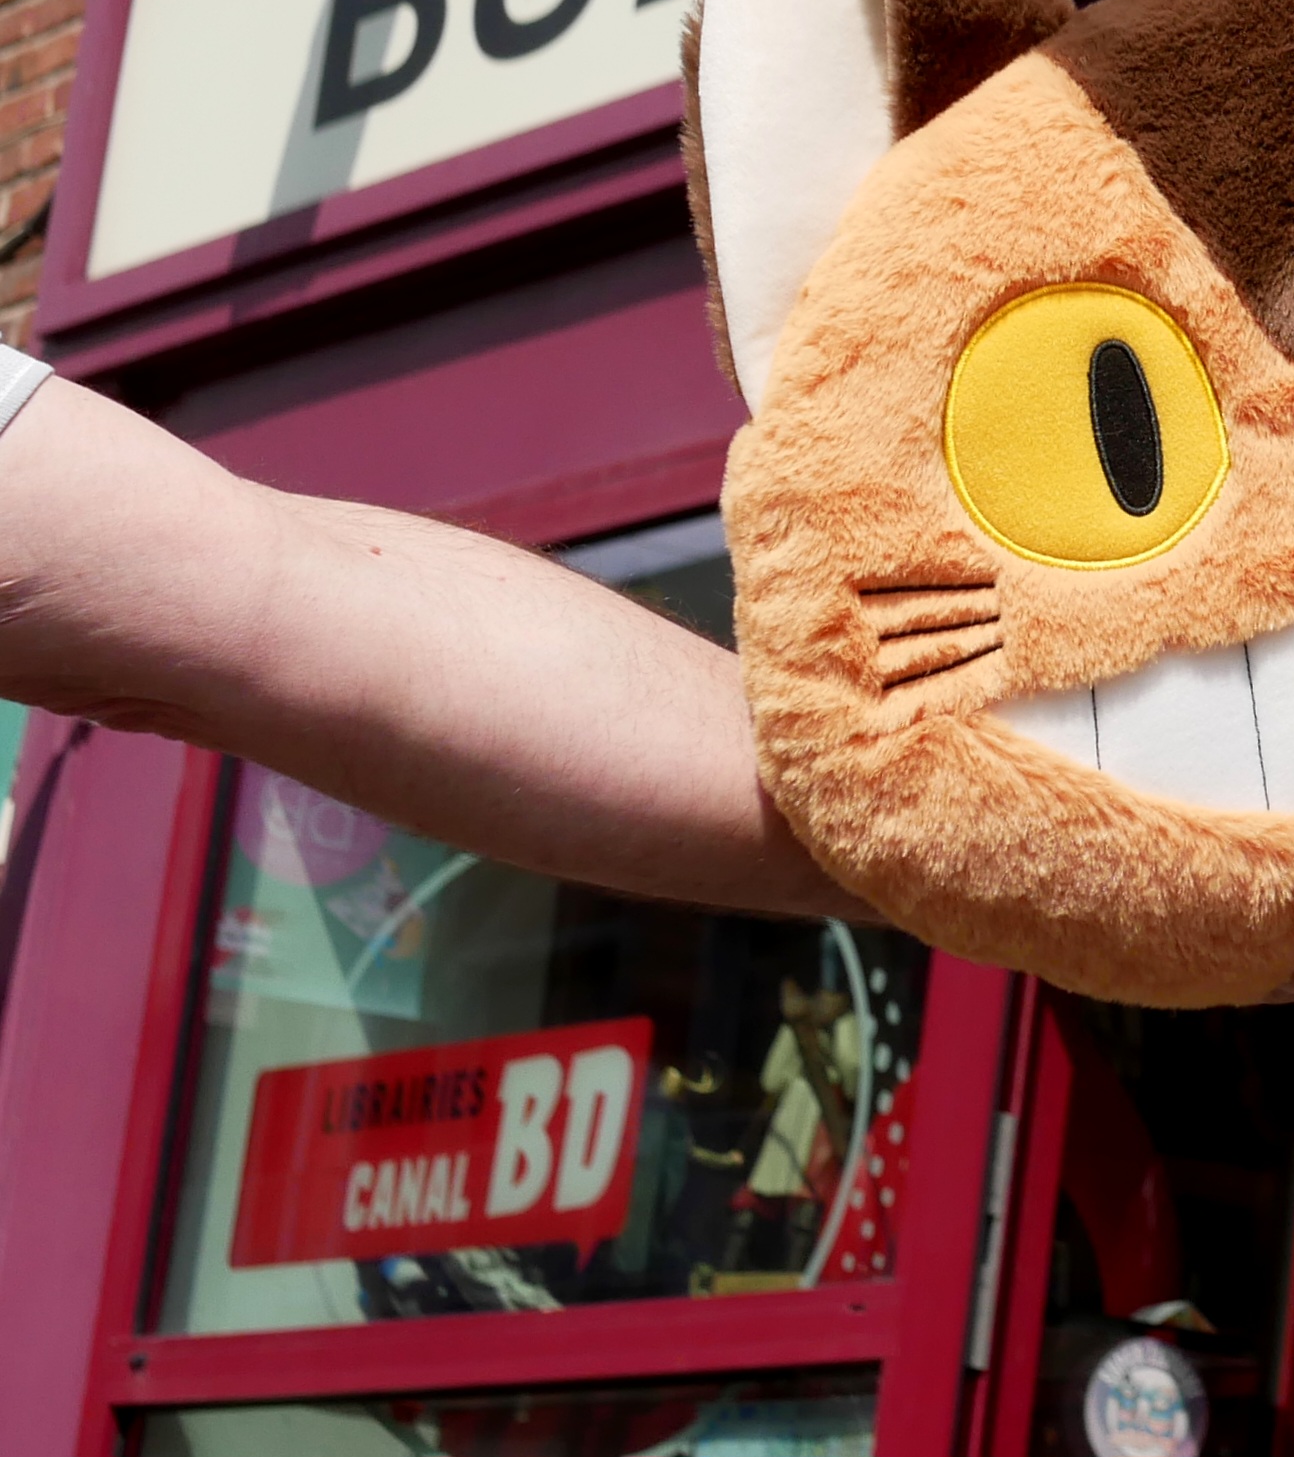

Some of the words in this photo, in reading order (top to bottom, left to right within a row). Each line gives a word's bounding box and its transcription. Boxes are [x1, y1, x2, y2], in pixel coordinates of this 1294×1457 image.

[323, 1067, 487, 1134] LIBRAIRIES
[344, 1150, 471, 1232] CANAL
[485, 1045, 634, 1219] BD
